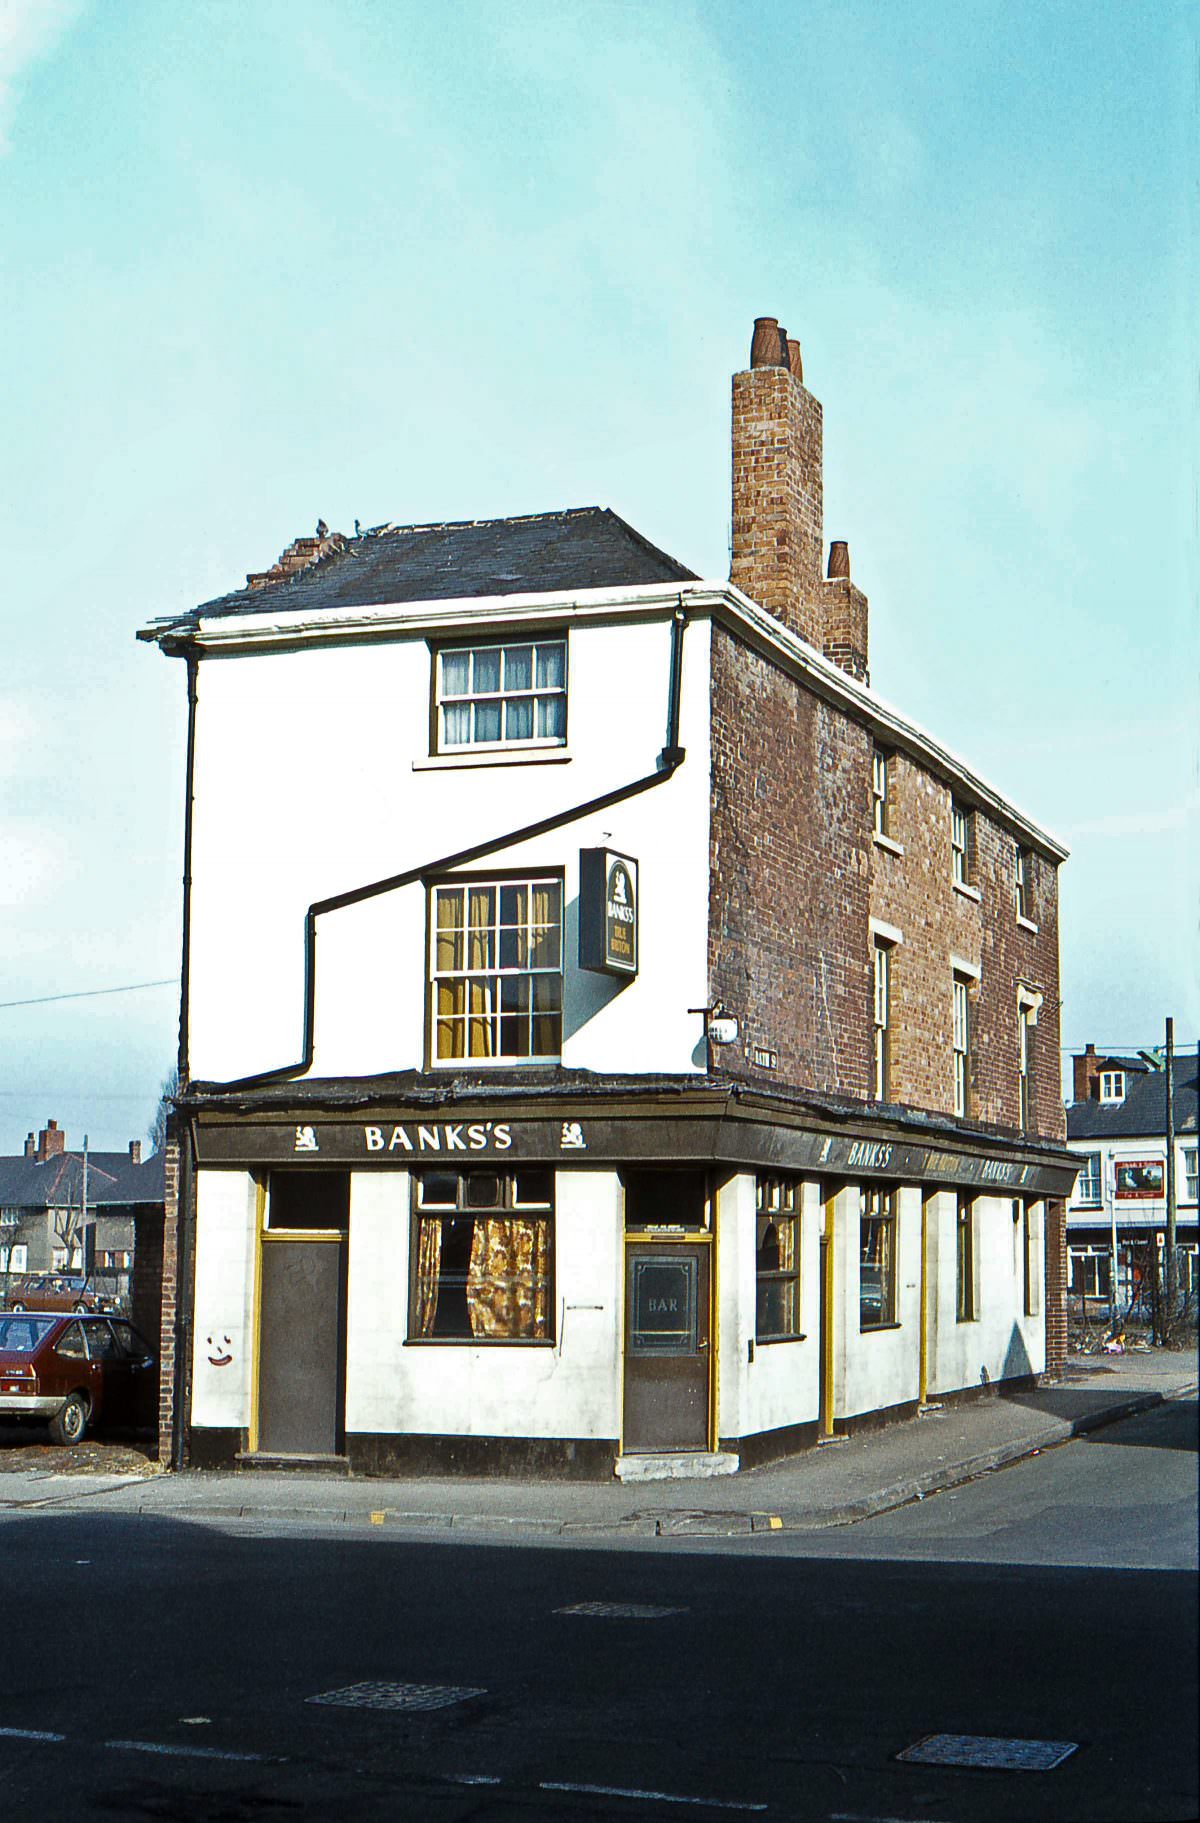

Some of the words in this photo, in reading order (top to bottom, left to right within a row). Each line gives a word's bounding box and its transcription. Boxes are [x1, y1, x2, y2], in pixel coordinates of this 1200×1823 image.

[365, 1123, 513, 1151] BANKS'S
[847, 1141, 893, 1168] BANKS'S
[648, 1298, 678, 1312] BAR
